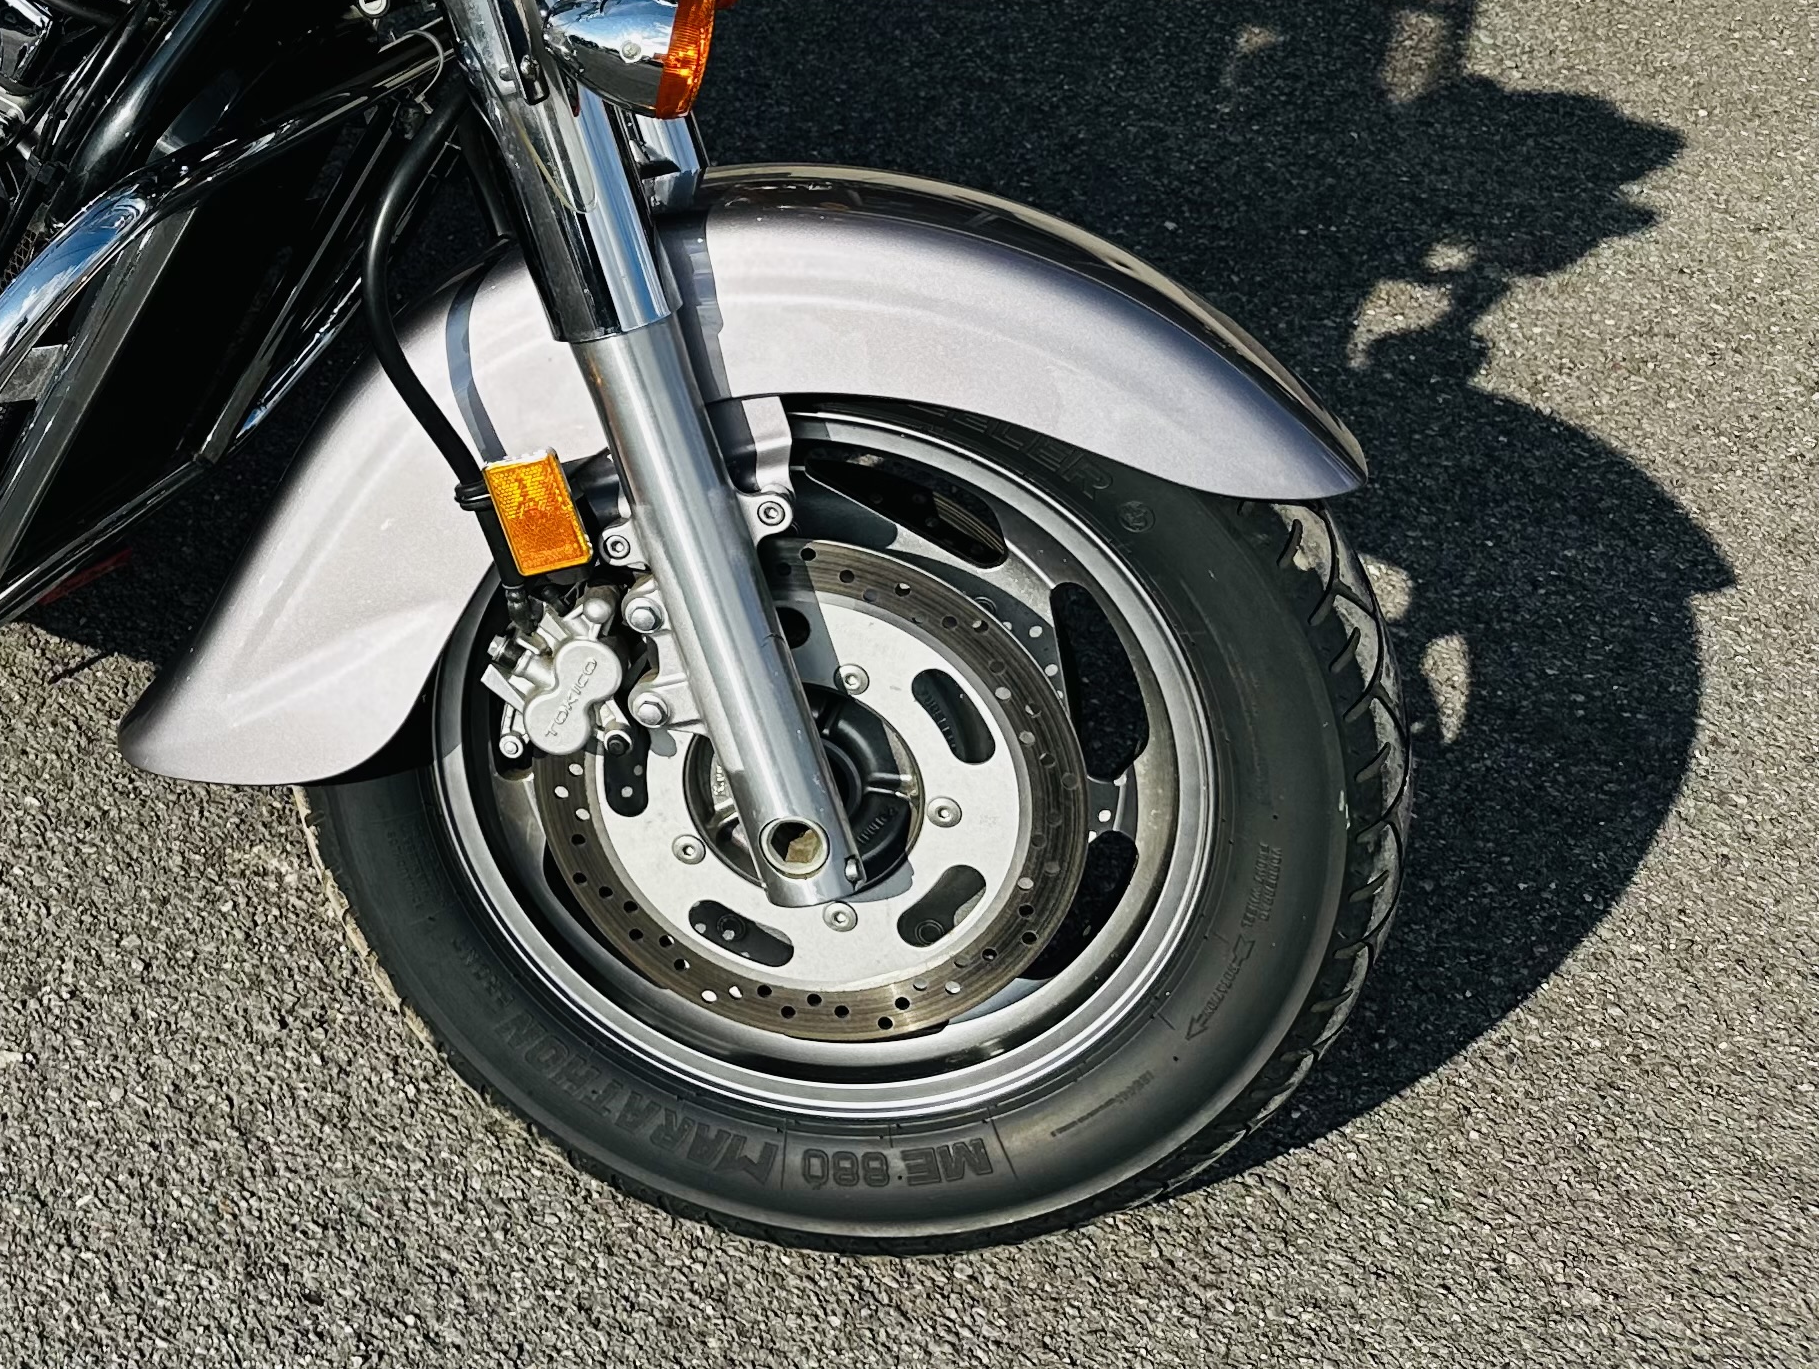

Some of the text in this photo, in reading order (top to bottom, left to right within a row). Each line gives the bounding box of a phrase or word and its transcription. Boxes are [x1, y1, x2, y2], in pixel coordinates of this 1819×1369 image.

[544, 656, 598, 738] TOKICO
[491, 1012, 780, 1186] MARATHON
[801, 1147, 891, 1189] 880
[900, 1137, 994, 1187] ME
